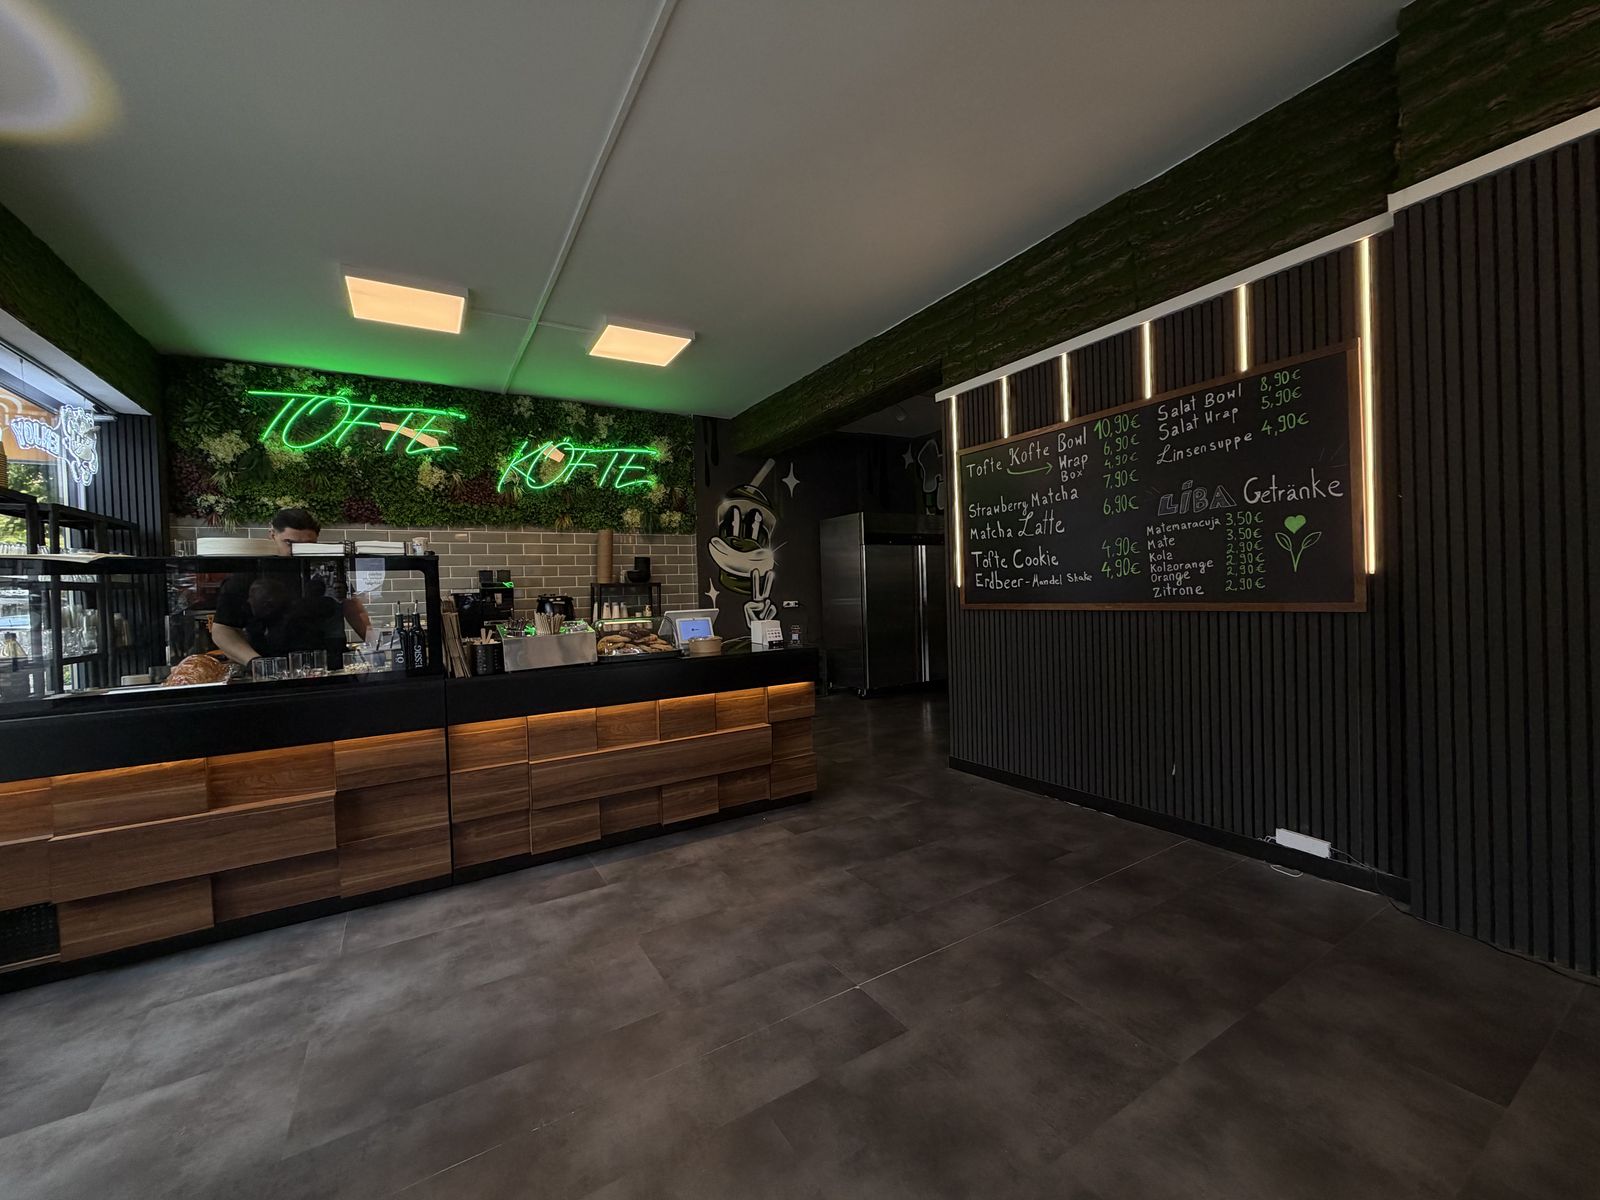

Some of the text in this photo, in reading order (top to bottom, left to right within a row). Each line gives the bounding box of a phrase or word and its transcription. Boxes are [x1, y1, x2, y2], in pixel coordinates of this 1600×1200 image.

[1157, 395, 1197, 421] Salat
[1204, 383, 1242, 408] Bowl
[1159, 414, 1199, 441] Salat
[1205, 406, 1239, 425] Wrap
[1057, 426, 1087, 452] Bowl
[1156, 431, 1253, 465] Linsensuppe
[1058, 453, 1089, 473] Wrap
[1061, 469, 1083, 482] Box
[1243, 467, 1344, 504] Getränke
[968, 495, 1029, 519] Strawberry
[1031, 484, 1079, 508] Matcha
[970, 521, 1013, 540] Matcha
[1018, 509, 1065, 537] Latte
[1146, 516, 1221, 536] Matemaracuja
[1147, 536, 1176, 550] Mate
[1012, 545, 1059, 569] Cookie
[1149, 550, 1173, 563] Kola
[1150, 560, 1214, 575] Kolaorange
[1066, 571, 1093, 585] Shake
[1151, 570, 1191, 586] Orange
[1153, 582, 1205, 598] Zitrone
[414, 644, 423, 669] ESSIG
